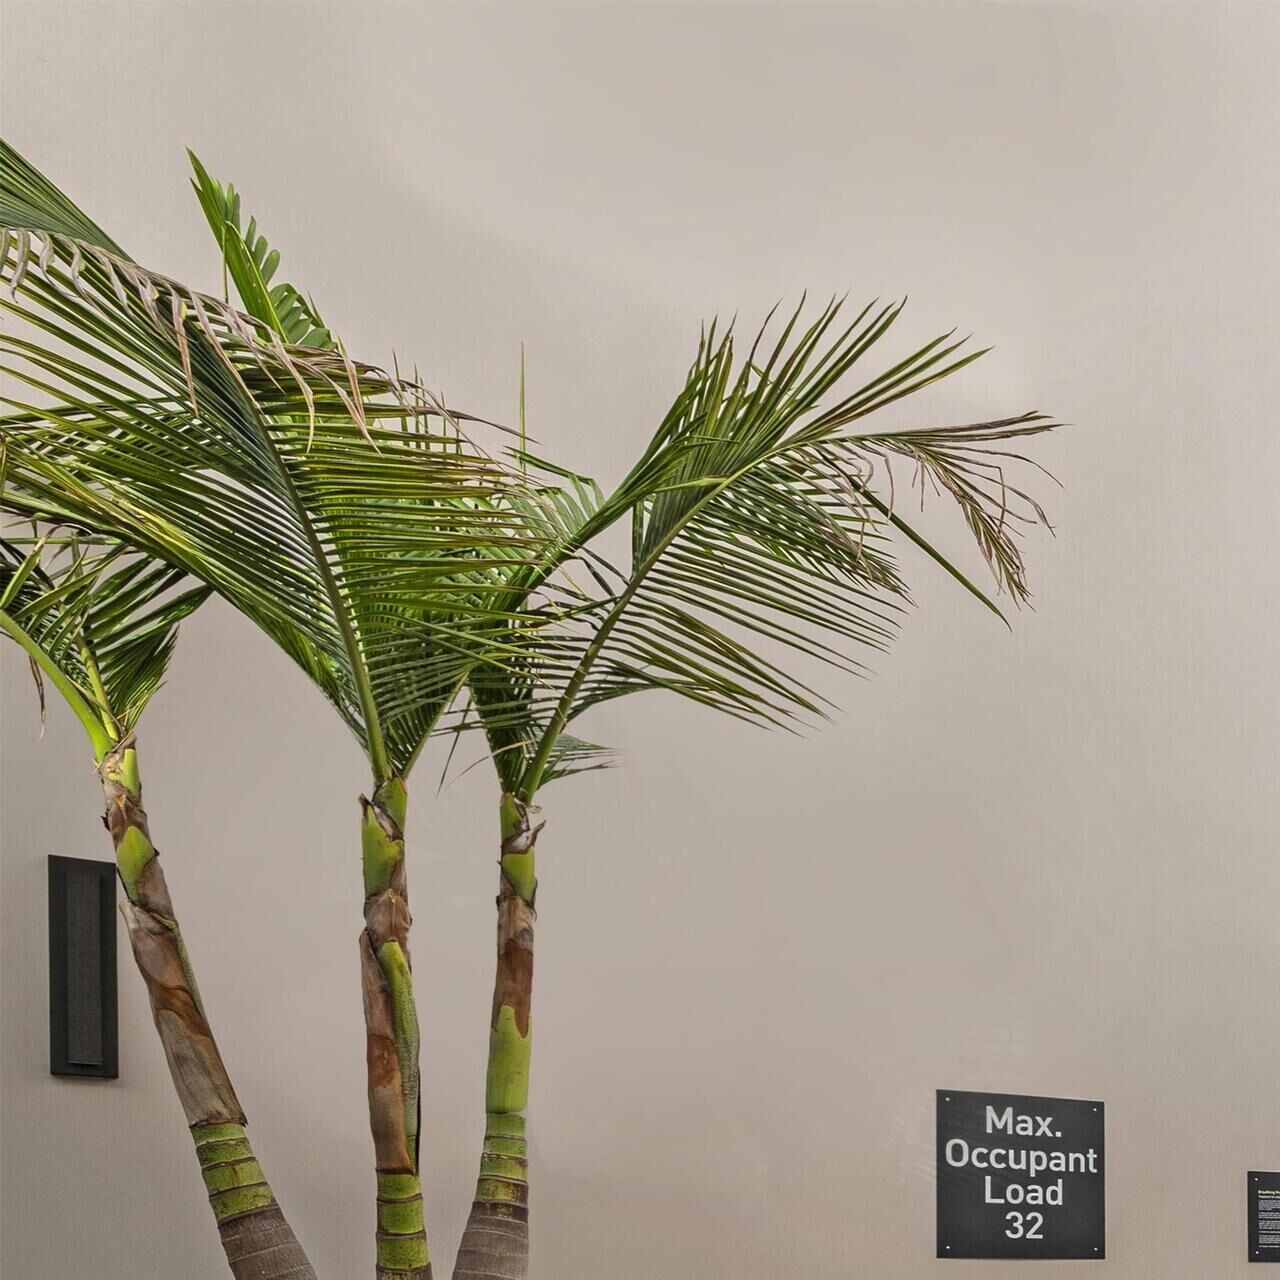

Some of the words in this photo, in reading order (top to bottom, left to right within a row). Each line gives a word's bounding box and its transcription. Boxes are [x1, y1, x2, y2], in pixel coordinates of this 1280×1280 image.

[985, 1105, 1062, 1138] Max.
[945, 1138, 1098, 1177] Occupant
[984, 1175, 1063, 1206] Load
[1004, 1211, 1044, 1239] 32
